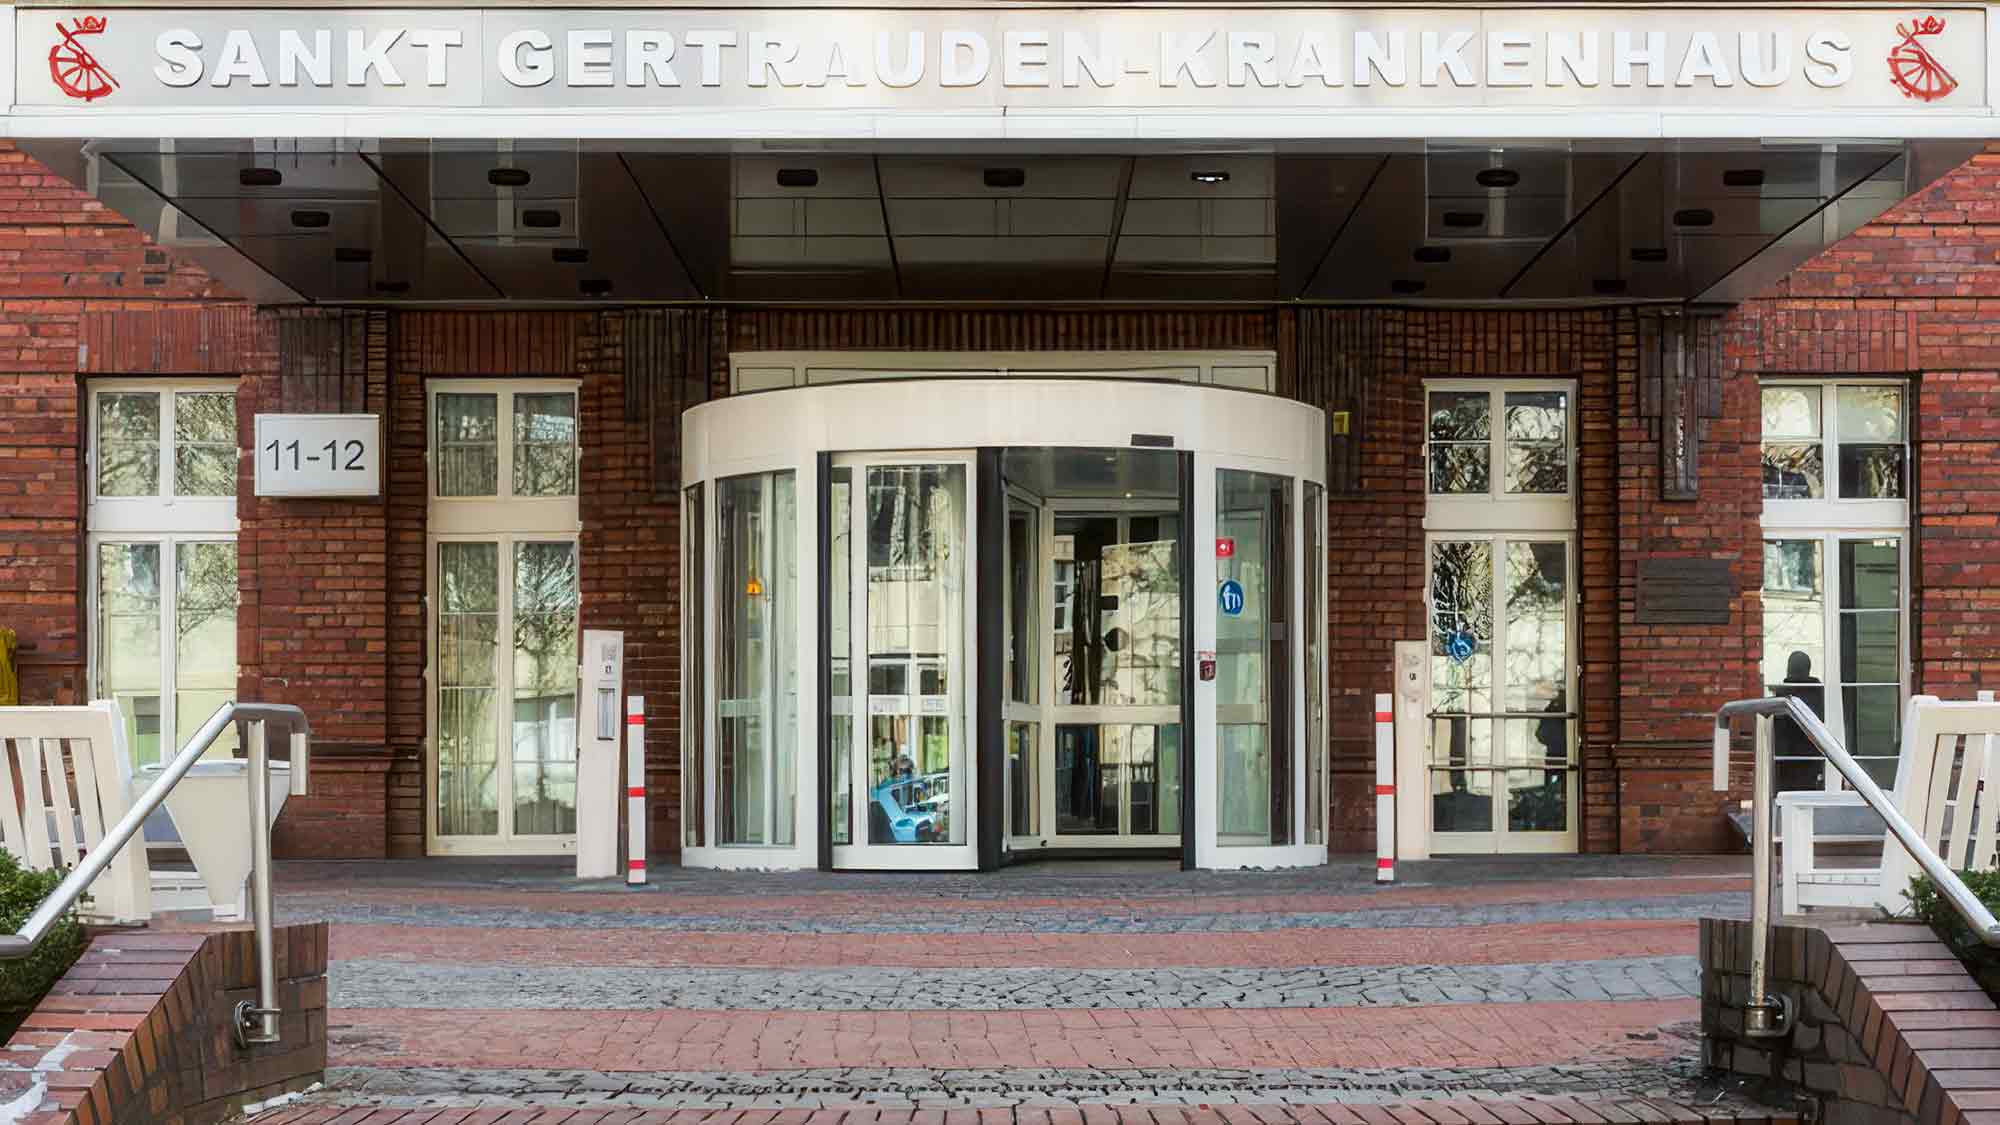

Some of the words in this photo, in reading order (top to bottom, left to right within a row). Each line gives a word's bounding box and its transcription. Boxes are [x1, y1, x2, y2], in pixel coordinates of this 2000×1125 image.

[153, 28, 463, 88] SANKT
[498, 28, 1854, 88] GERTRAUDEN-KRANKENHAUS
[265, 439, 366, 471] 11-12
